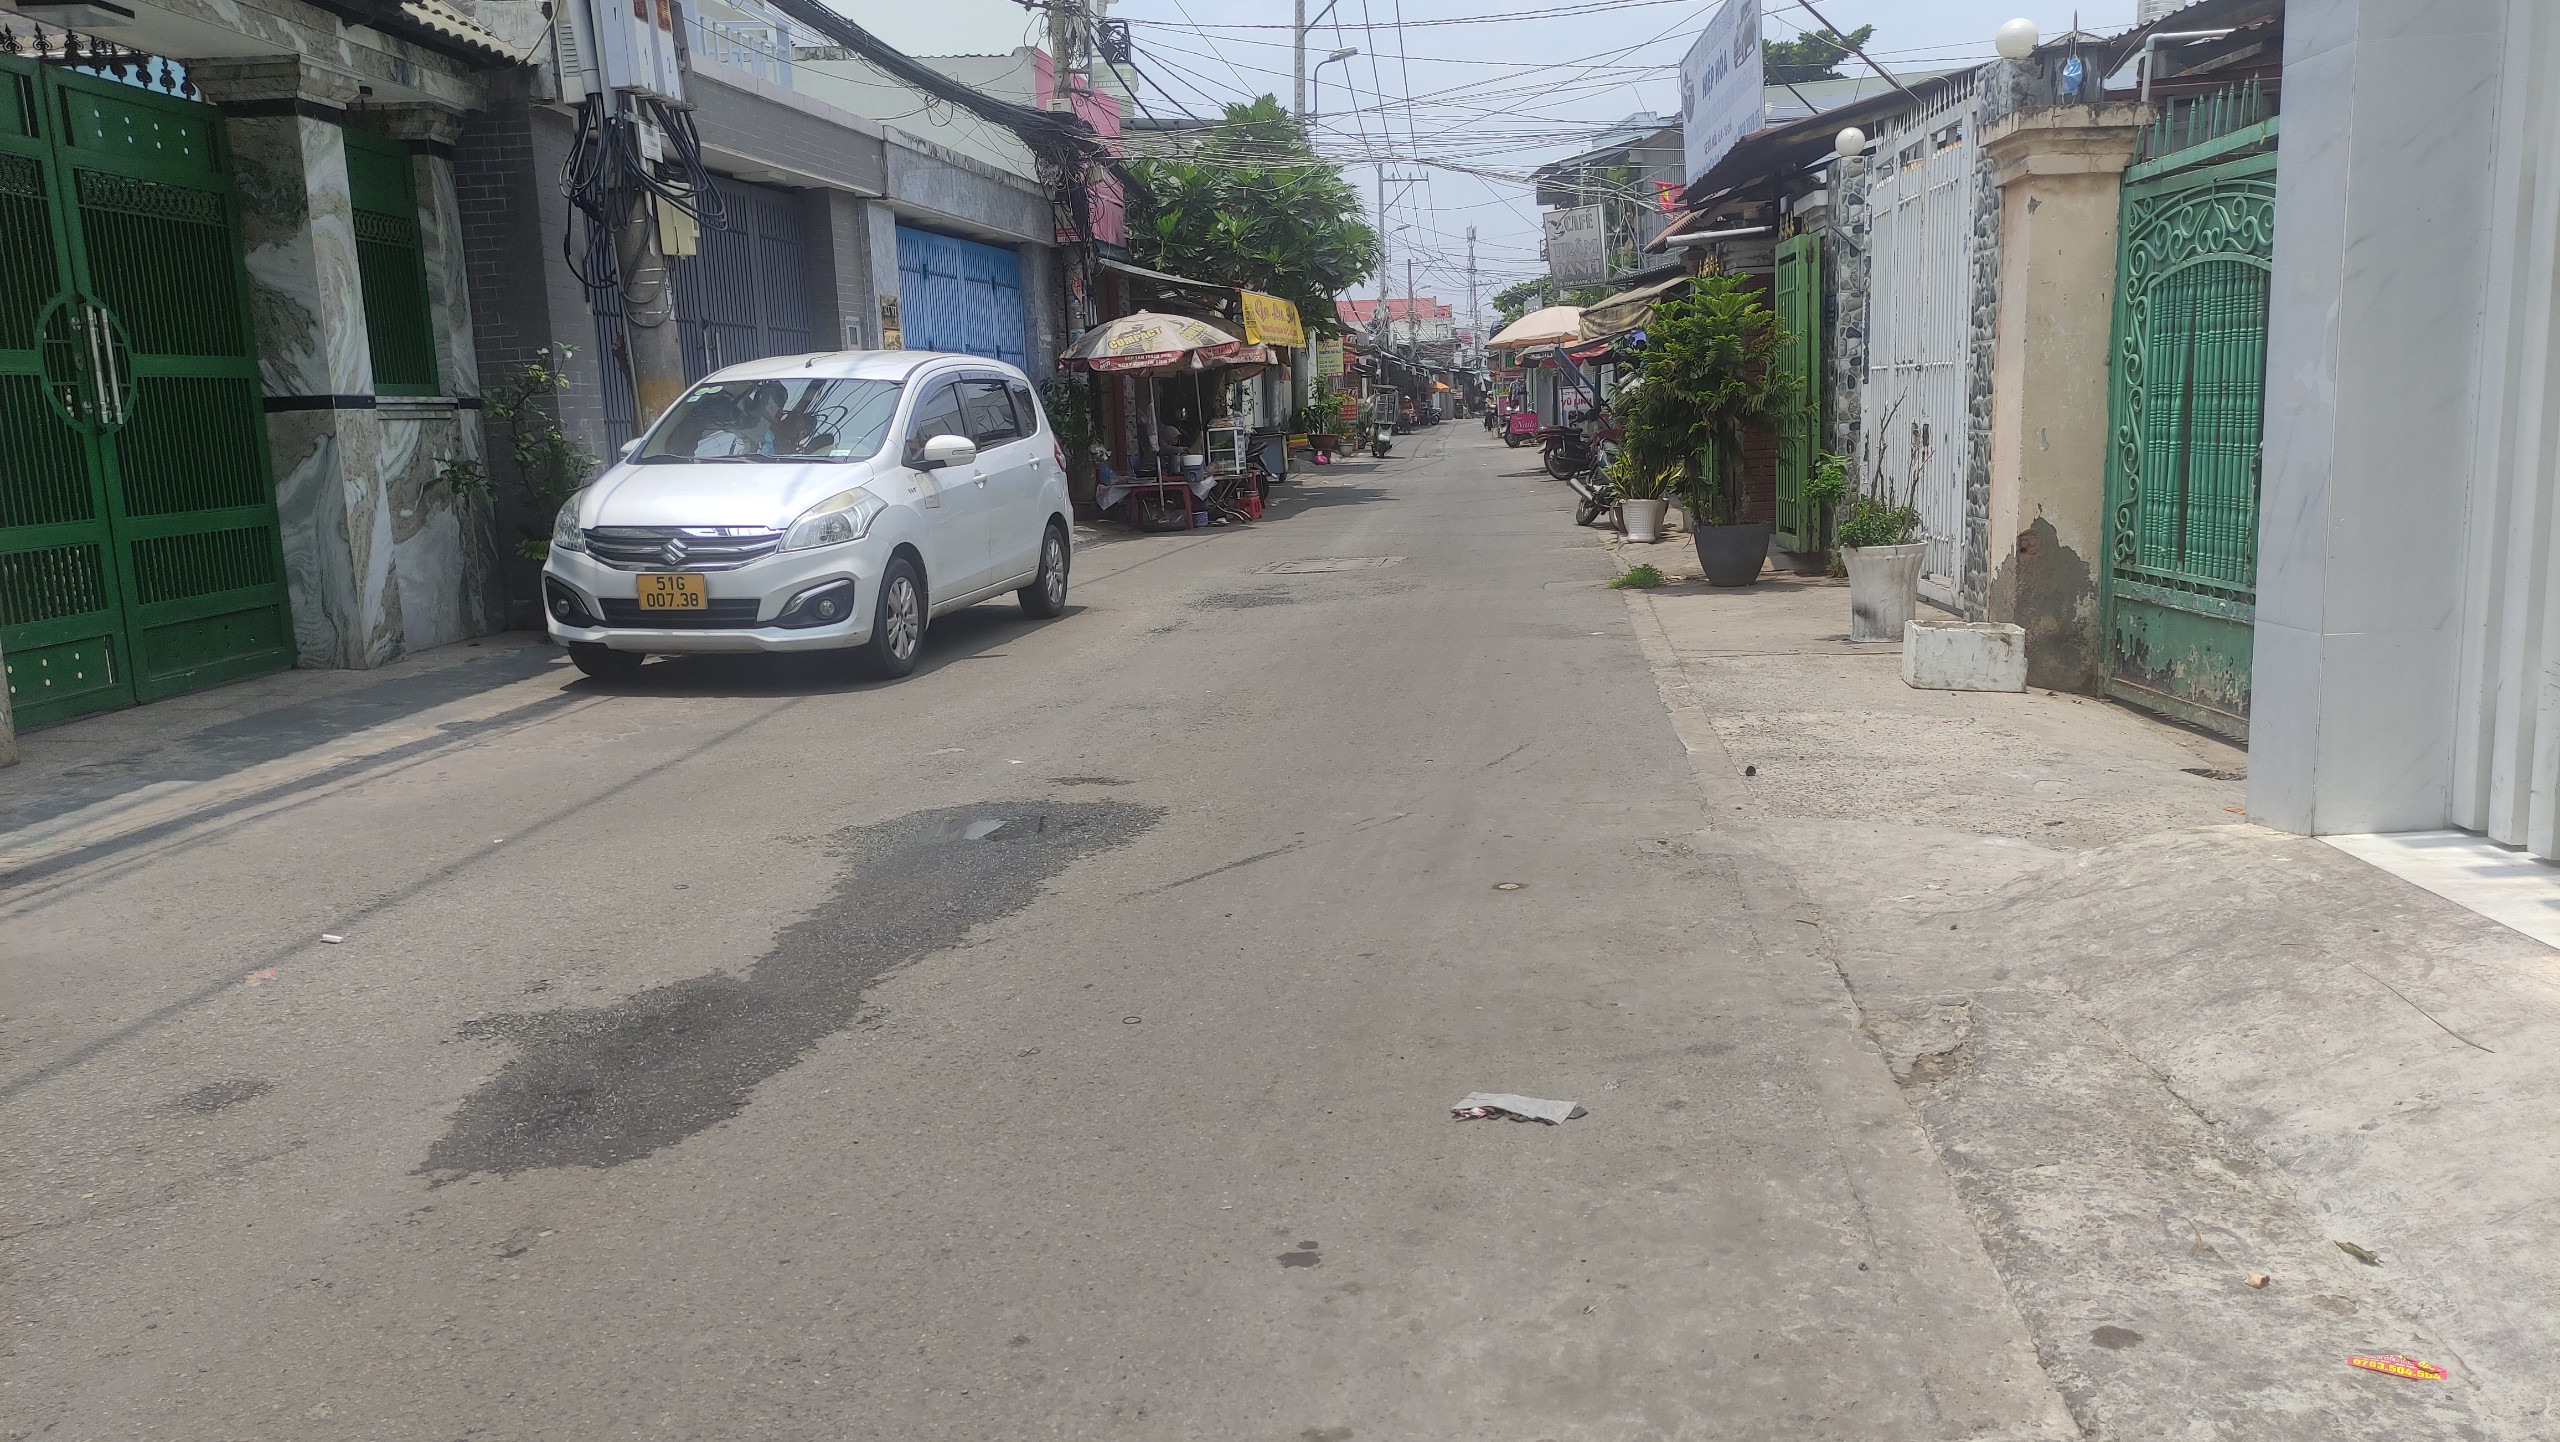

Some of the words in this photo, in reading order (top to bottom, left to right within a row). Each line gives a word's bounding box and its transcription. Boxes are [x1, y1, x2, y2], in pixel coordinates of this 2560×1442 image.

[1563, 208, 1593, 232] CAFÉ
[1554, 258, 1600, 278] OANH
[1108, 326, 1162, 349] COMPACT
[656, 576, 686, 591] 51G
[646, 592, 699, 607] 007.38
